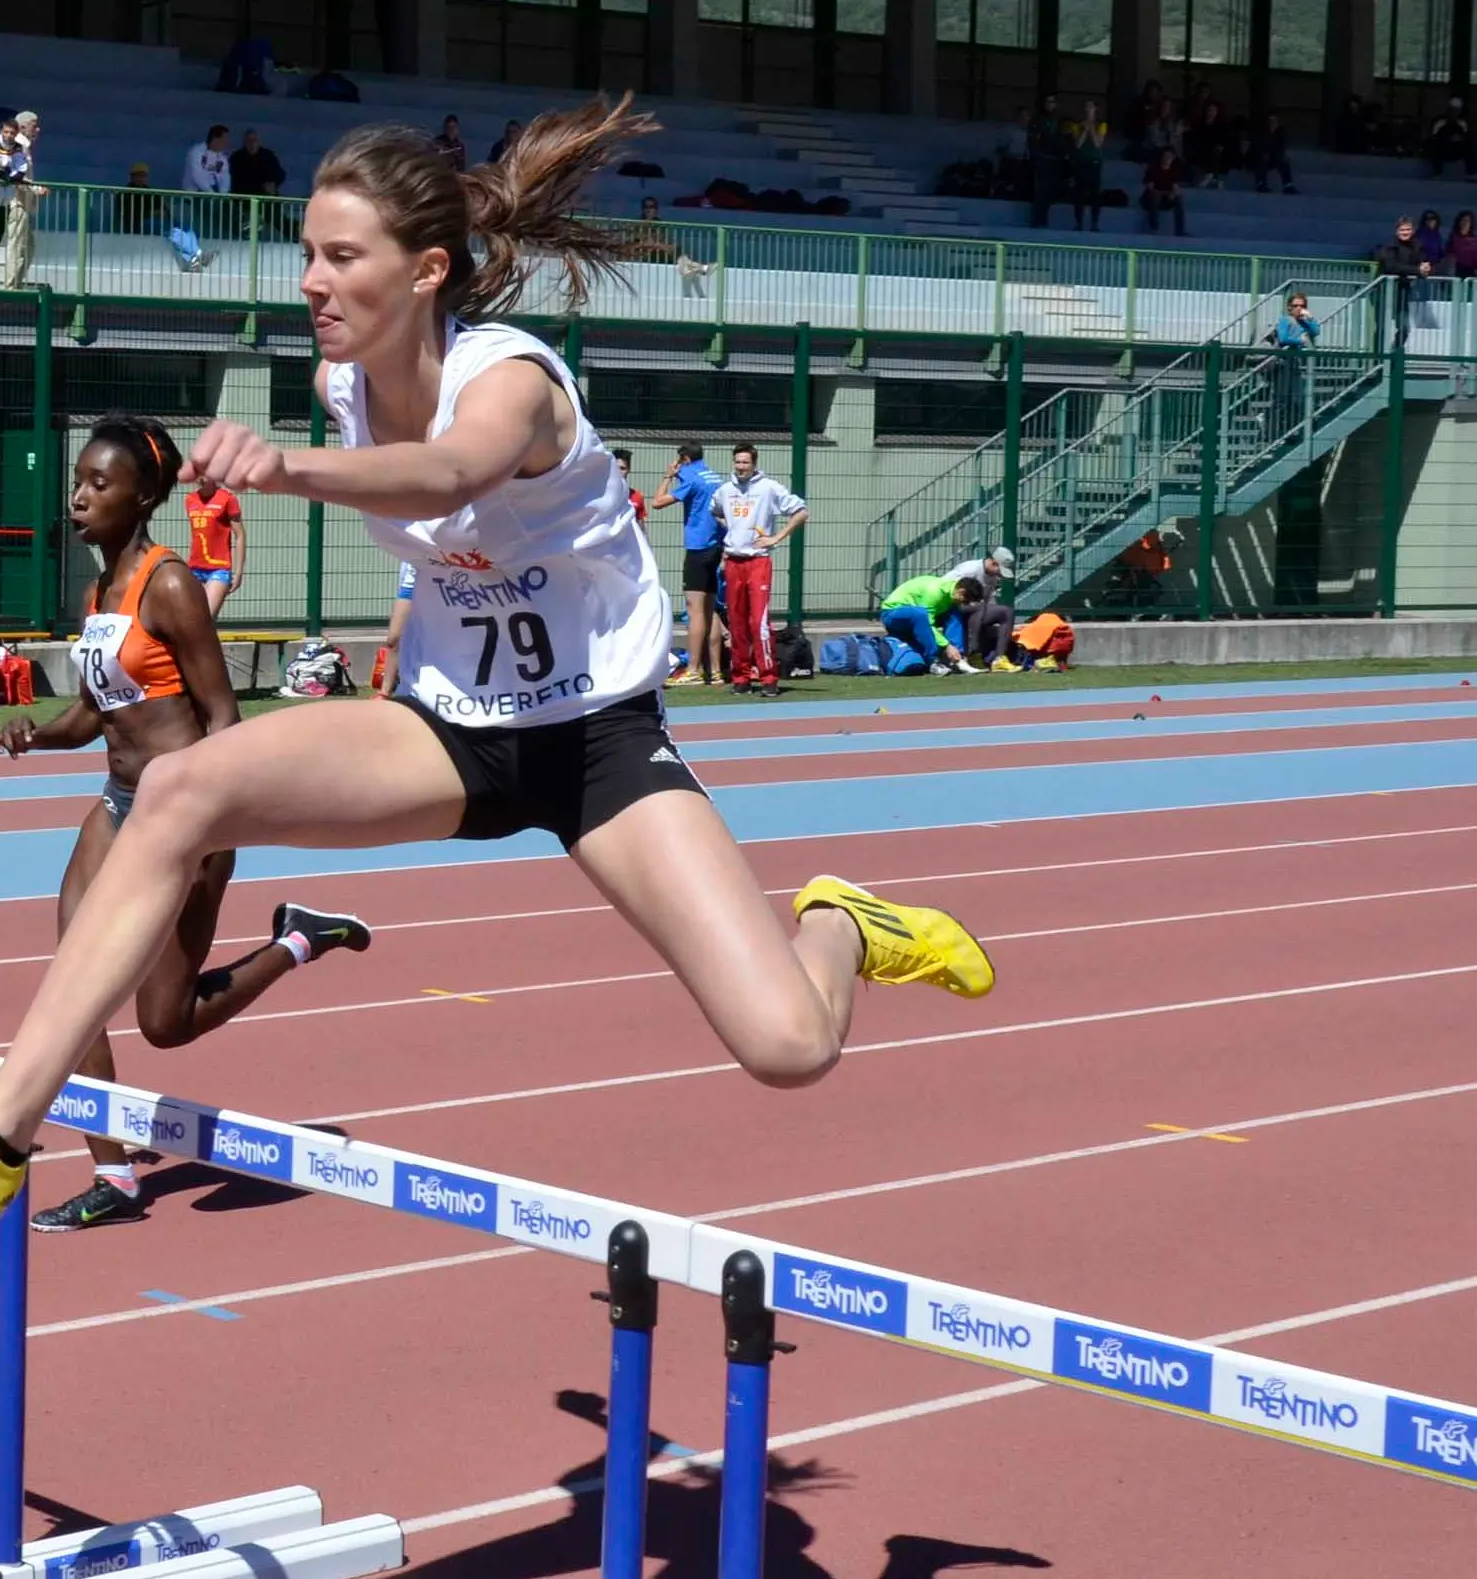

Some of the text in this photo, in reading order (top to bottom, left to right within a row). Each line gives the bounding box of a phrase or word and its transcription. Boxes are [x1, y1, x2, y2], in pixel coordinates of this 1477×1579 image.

[432, 566, 548, 610] TRENTINO
[79, 648, 109, 689] 78
[460, 611, 555, 687] 79
[50, 1093, 592, 1242] ENTINO TRENTINO TRENTINO TRENTINO TRENTINO TRENTINO
[790, 1268, 1477, 1467] TRENTINO TRENTINO TRENTINO TRENTINO TREN
